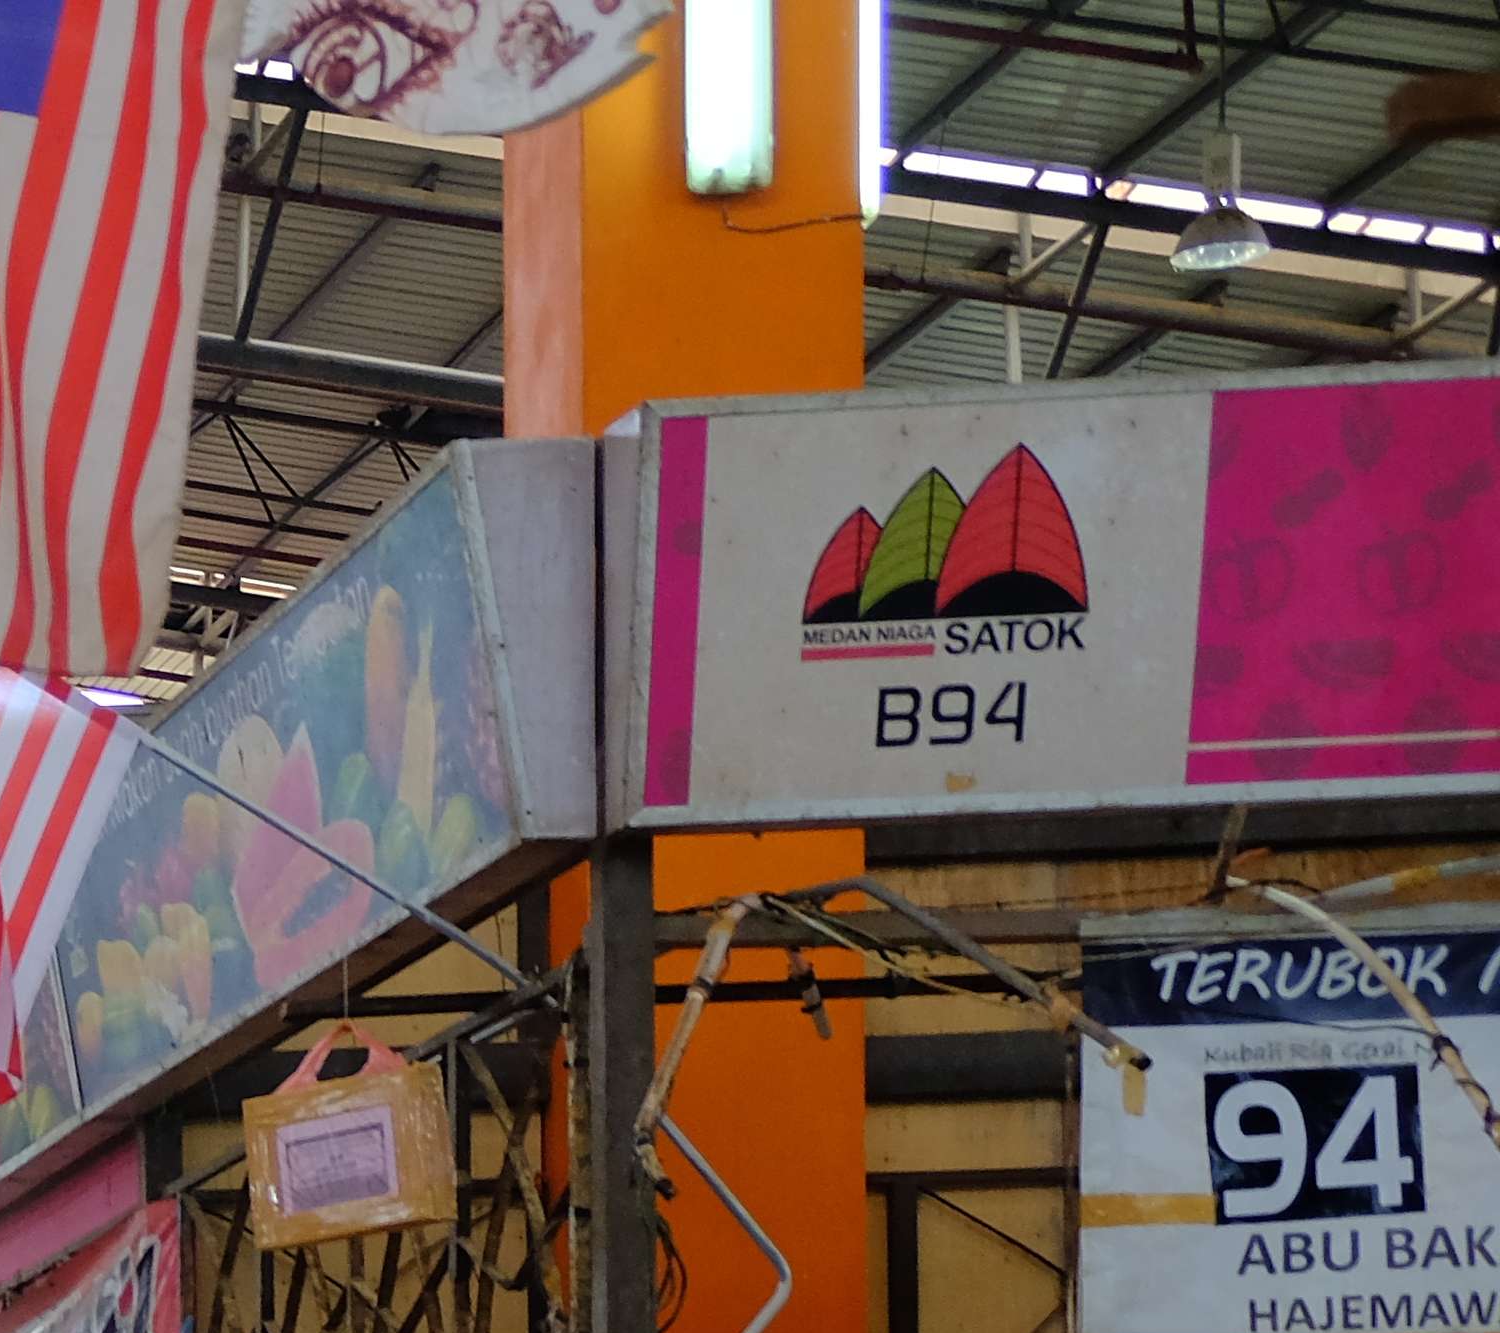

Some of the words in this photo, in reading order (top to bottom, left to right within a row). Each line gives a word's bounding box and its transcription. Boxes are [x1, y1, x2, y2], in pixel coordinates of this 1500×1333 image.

[802, 626, 871, 647] MEDAN
[877, 623, 938, 644] NIAGA
[943, 616, 1087, 657] SATOK
[874, 680, 1029, 750] B94
[1151, 944, 1451, 1006] TERUBOK
[1213, 1075, 1415, 1218] 94
[1237, 1230, 1361, 1277] ABU
